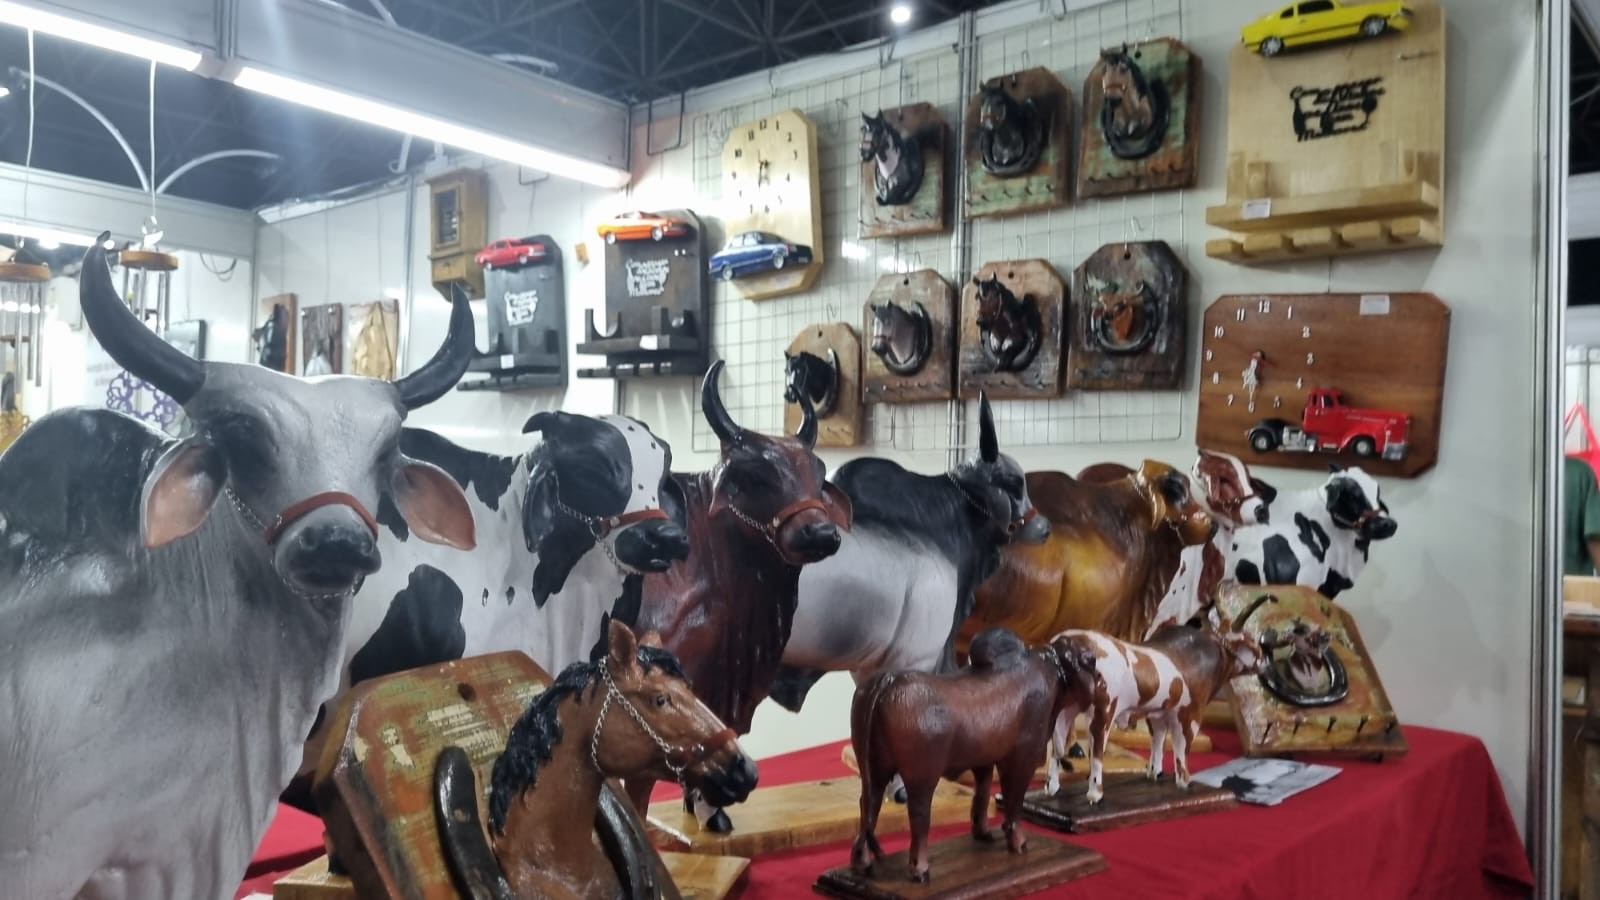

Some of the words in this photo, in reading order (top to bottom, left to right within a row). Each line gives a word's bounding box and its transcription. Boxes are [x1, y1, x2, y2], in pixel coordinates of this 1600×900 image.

[1258, 299, 1271, 313] 12
[1288, 305, 1292, 320] 1
[1236, 308, 1246, 321] 11
[1214, 325, 1224, 338] 10
[1206, 349, 1213, 362] 9
[1296, 376, 1303, 390] 4
[1227, 393, 1234, 406] 7
[1248, 401, 1254, 413] 6
